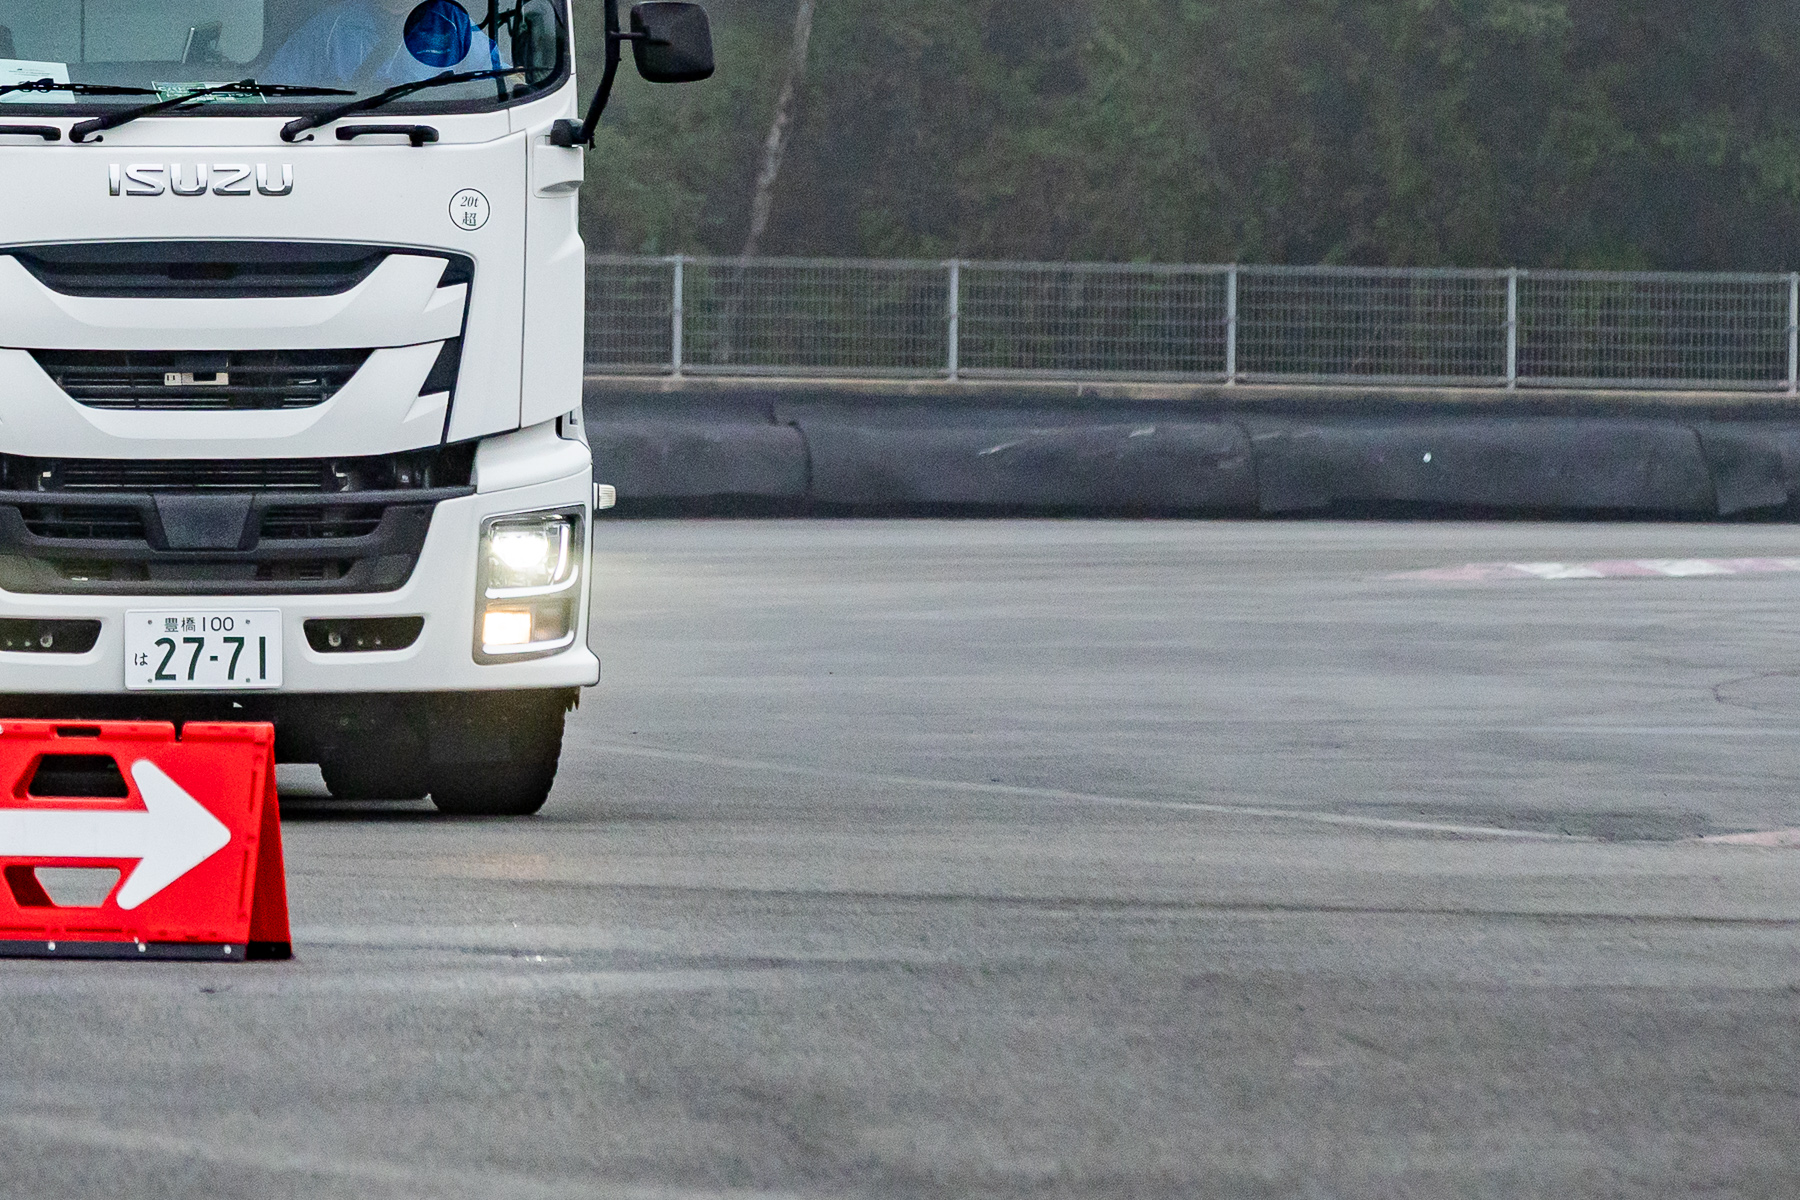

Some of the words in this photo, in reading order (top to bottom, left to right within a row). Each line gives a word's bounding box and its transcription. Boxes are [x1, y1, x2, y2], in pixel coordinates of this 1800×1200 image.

[108, 163, 294, 196] ISUZU
[460, 195, 479, 208] 20t
[164, 617, 196, 633] 豊橋
[202, 616, 235, 632] 100
[134, 652, 149, 667] は
[154, 636, 267, 681] 27-71
